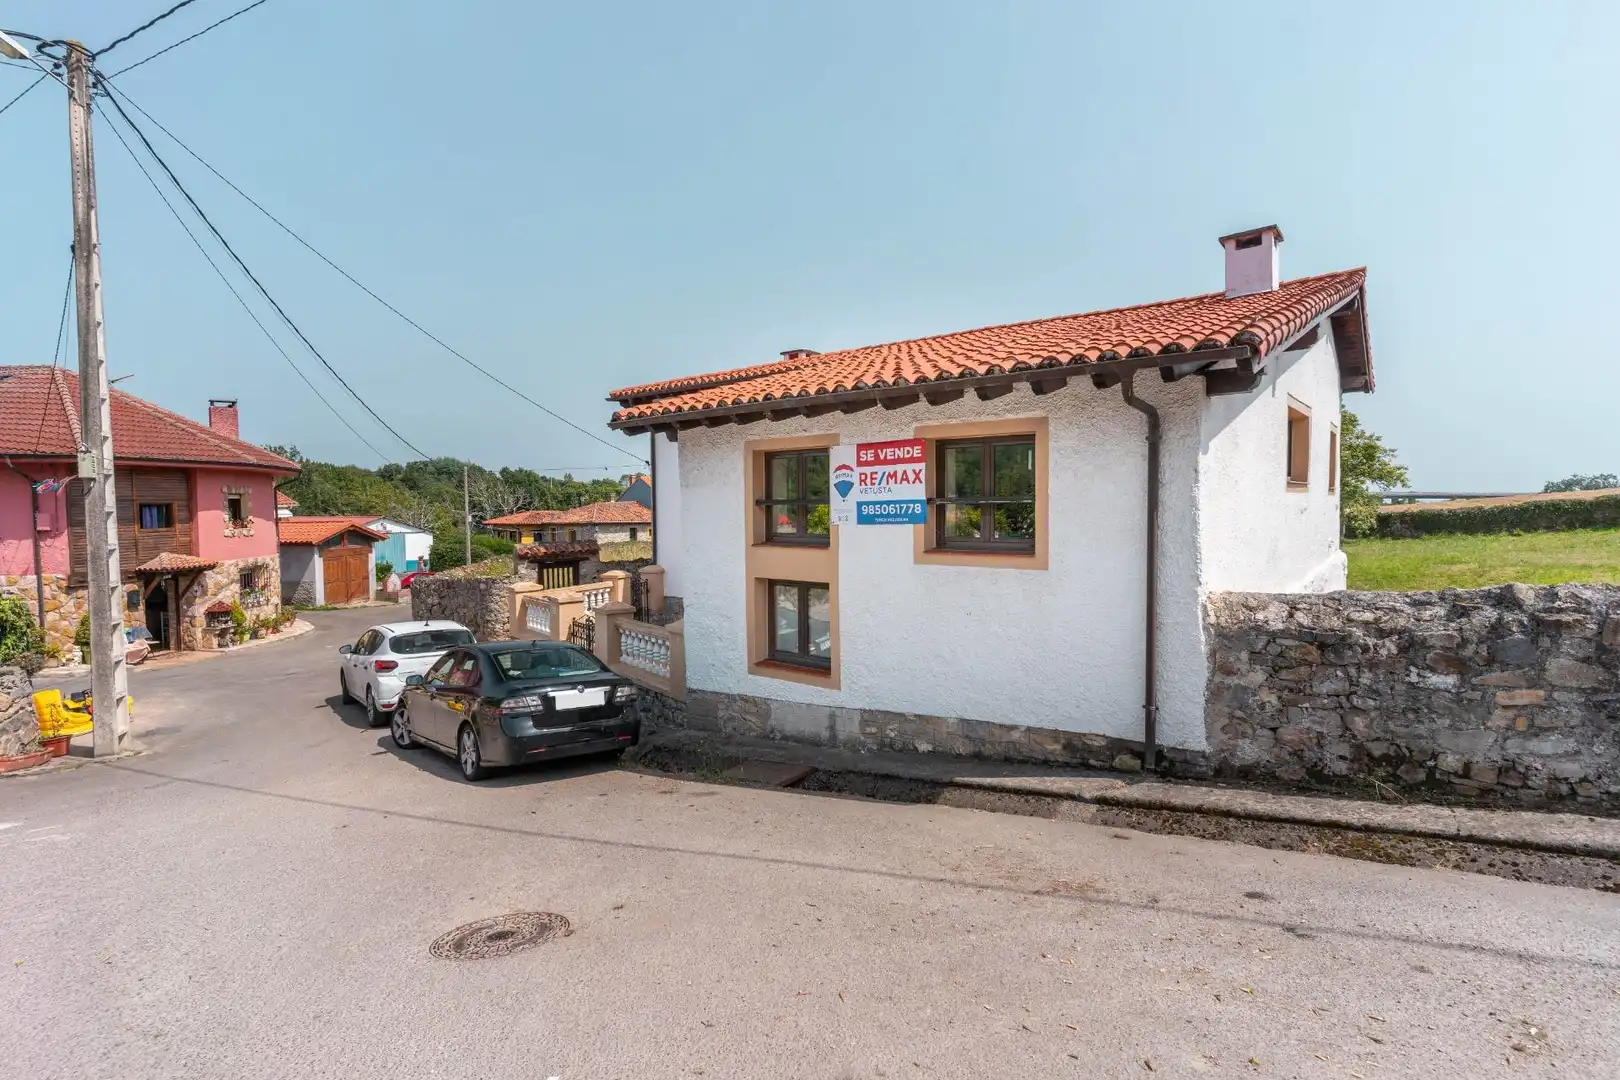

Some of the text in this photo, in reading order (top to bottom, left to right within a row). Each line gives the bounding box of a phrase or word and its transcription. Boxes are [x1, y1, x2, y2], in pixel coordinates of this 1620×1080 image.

[859, 446, 922, 461] SE VENDE
[859, 468, 923, 486] RE/MAX
[859, 486, 893, 495] VETUSTA
[861, 503, 922, 515] 985061778
